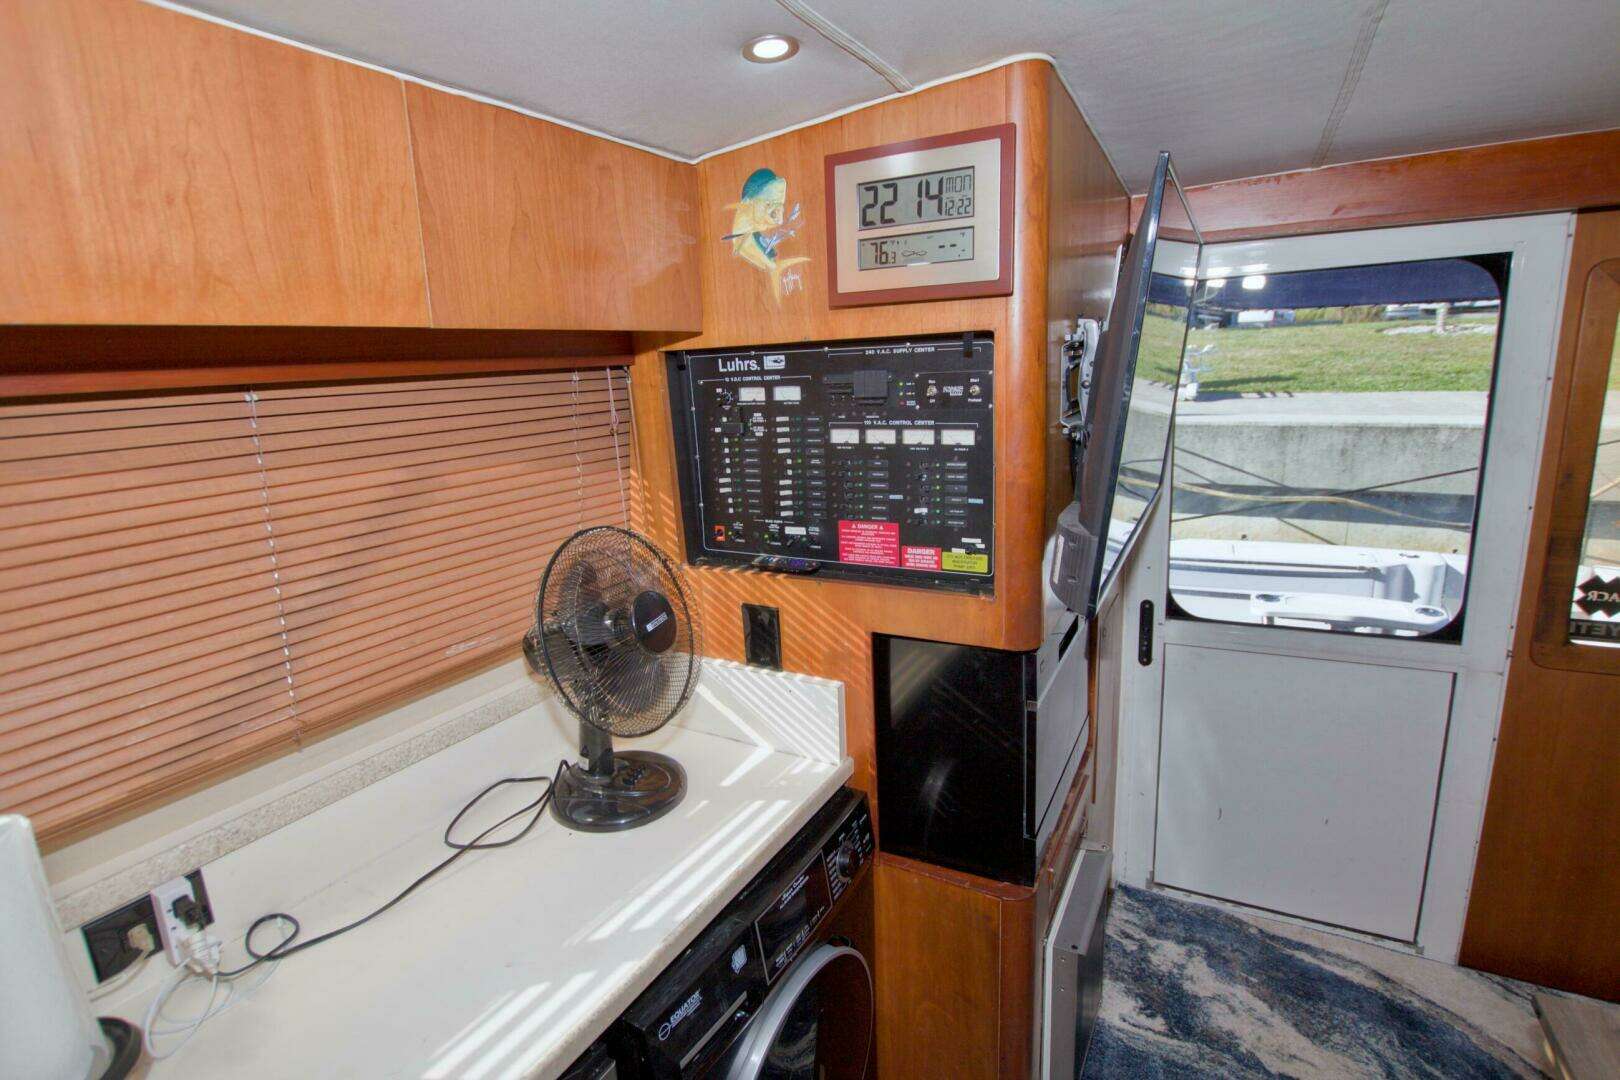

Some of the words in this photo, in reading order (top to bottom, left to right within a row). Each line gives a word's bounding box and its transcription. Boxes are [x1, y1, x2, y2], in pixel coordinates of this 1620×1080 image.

[861, 182, 898, 227] 22
[917, 176, 944, 218] 14
[857, 523, 879, 531] DANGER
[906, 547, 936, 556] DANGER
